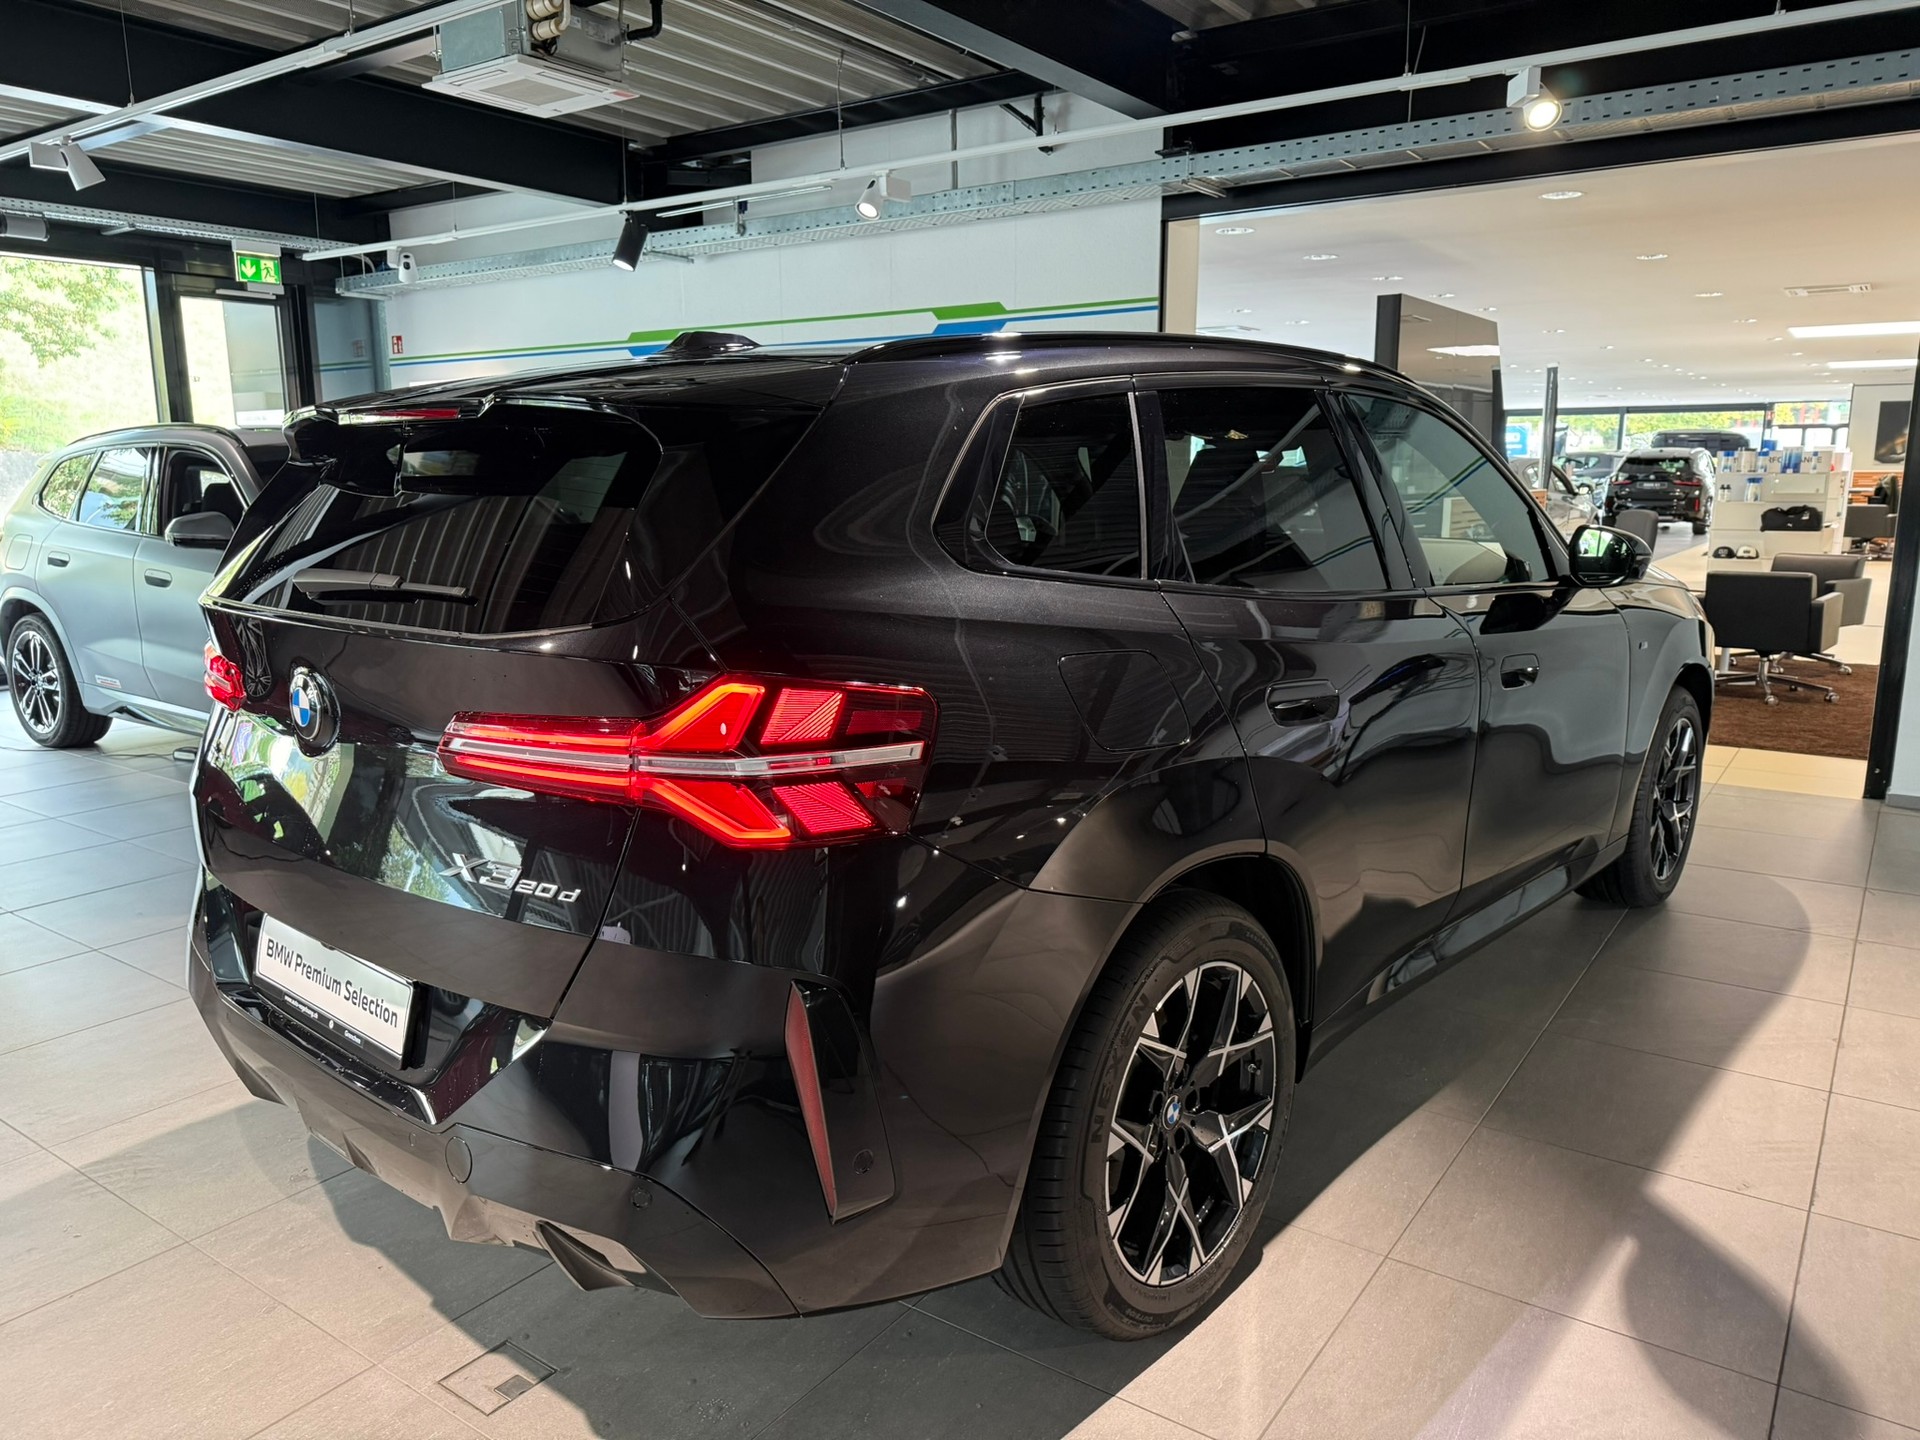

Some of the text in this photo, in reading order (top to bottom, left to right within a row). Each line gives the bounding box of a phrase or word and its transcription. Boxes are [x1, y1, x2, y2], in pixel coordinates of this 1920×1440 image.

[439, 852, 523, 890] X3
[266, 938, 295, 969] BMW
[294, 953, 342, 997] Premium
[343, 979, 398, 1029] Selection
[1090, 991, 1151, 1144] NEXEN
